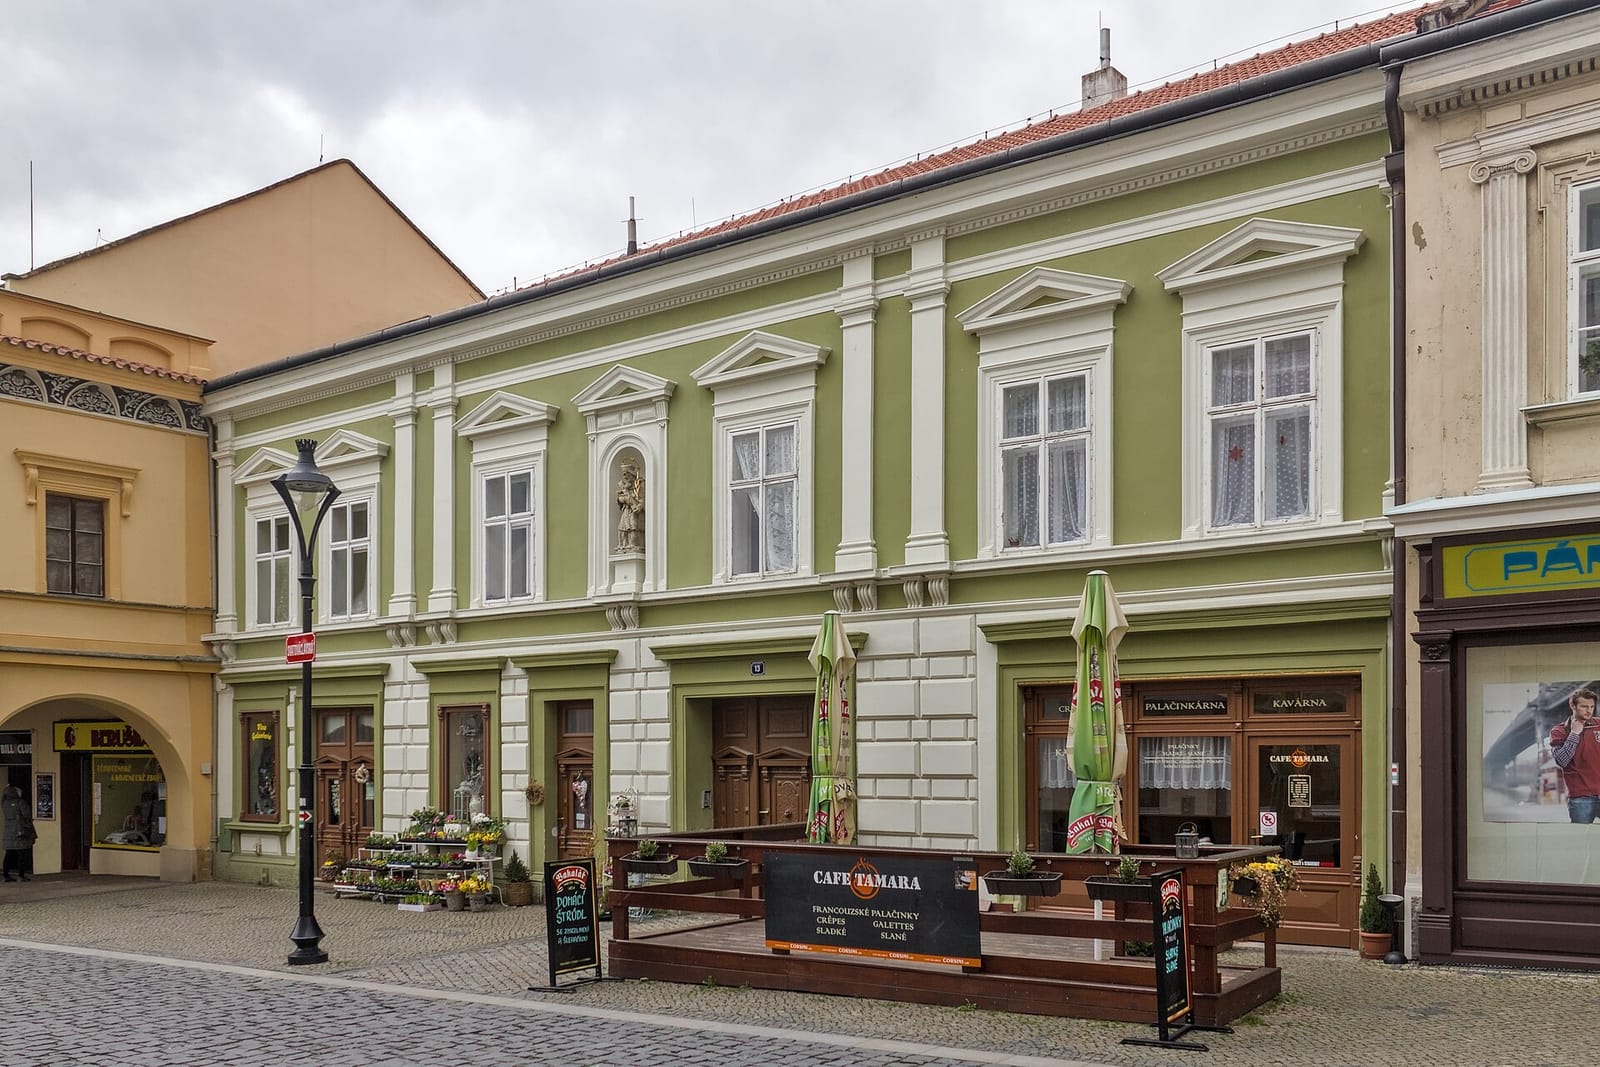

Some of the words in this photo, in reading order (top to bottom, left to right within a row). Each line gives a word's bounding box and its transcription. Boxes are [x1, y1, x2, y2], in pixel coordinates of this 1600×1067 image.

[1144, 700, 1226, 711] PALAČINKÁRNA
[1272, 698, 1327, 708] KAVÁRNA
[1269, 755, 1291, 763] CAFE
[1293, 755, 1329, 763] TAMARA
[813, 870, 851, 886] CAFE
[854, 873, 921, 890] TAMARA
[812, 905, 870, 917] FRANCOUZSKÉ
[871, 909, 920, 920] PALAČINKY
[816, 915, 846, 926] CRÊPES
[872, 920, 915, 931] GALETTES
[816, 926, 847, 936] SLADKÉ
[880, 931, 907, 941] SLANÉ
